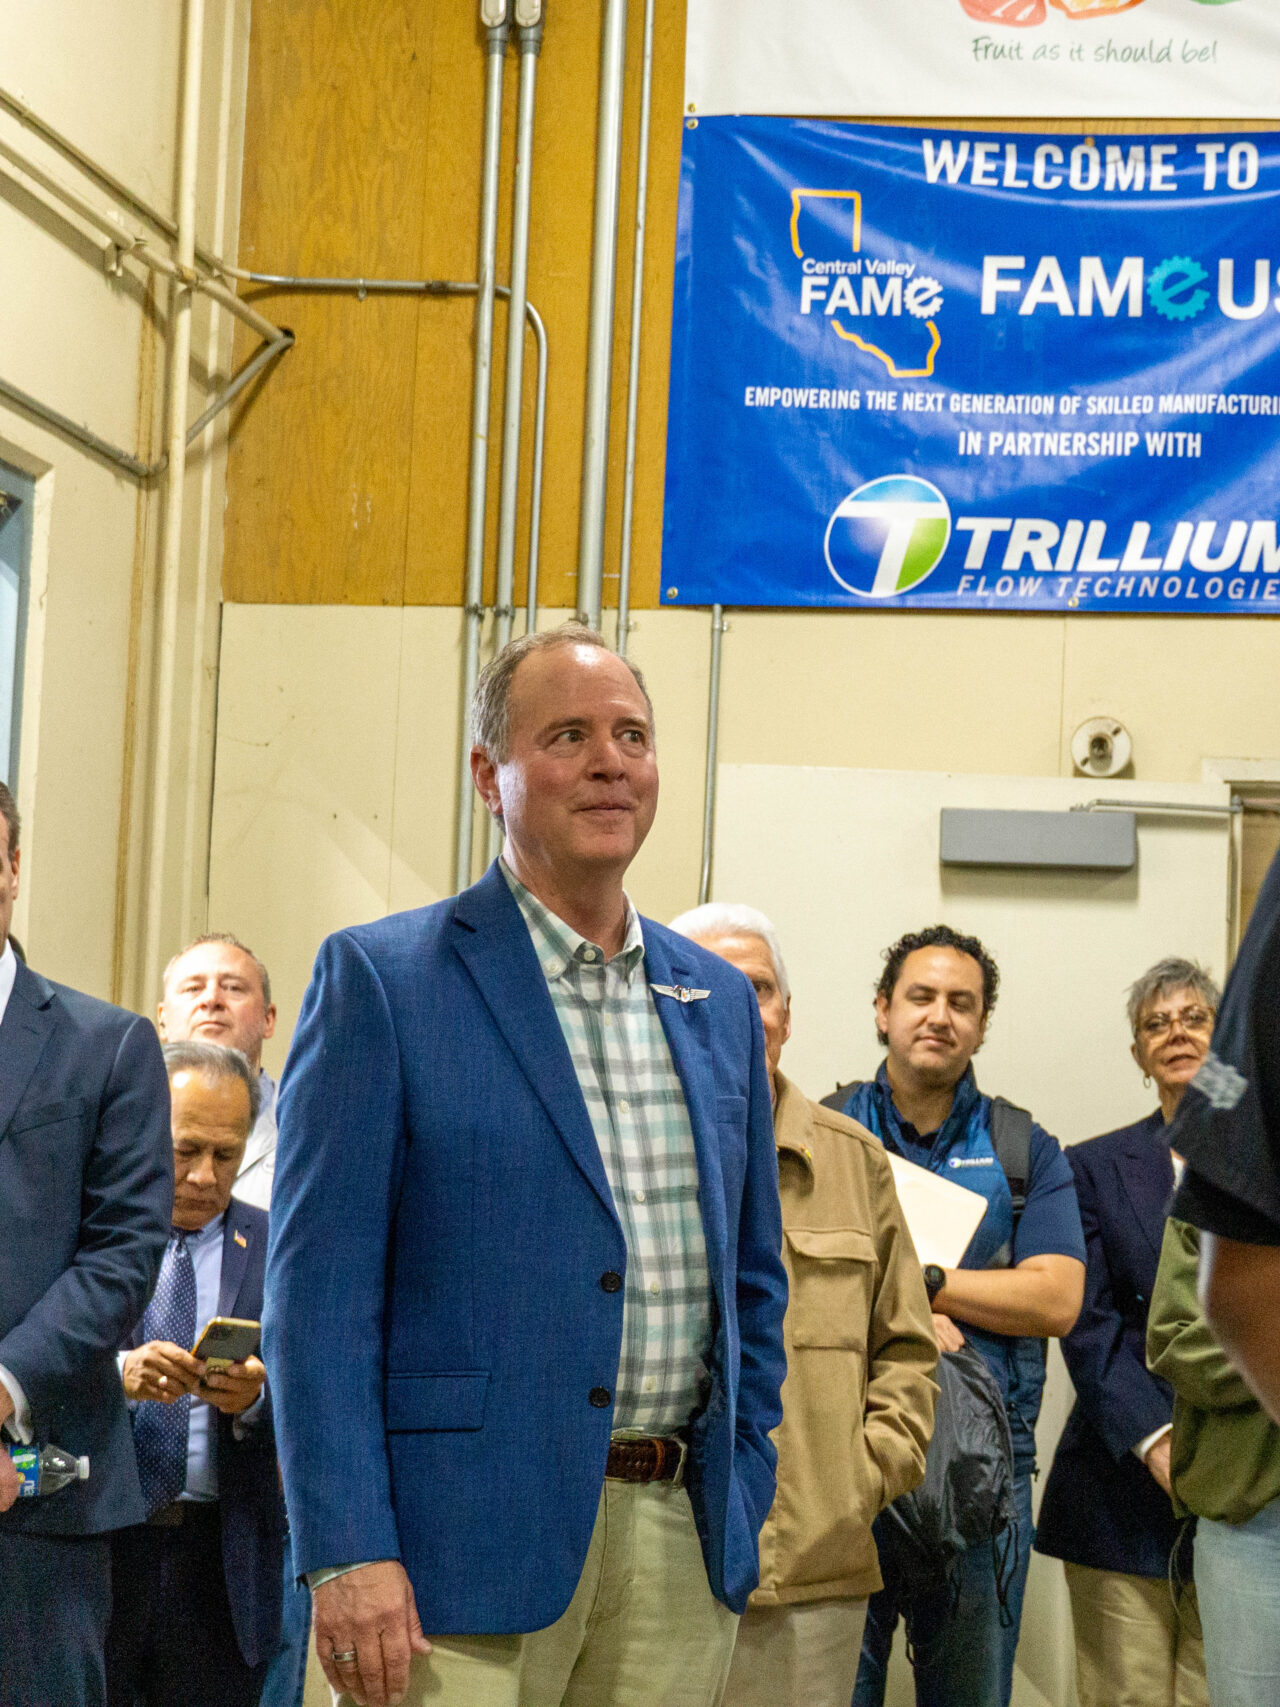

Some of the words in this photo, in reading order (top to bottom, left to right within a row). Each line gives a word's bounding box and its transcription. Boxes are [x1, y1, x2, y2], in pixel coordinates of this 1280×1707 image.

[972, 36, 1024, 62] Fruit
[1032, 44, 1060, 61] as
[1069, 40, 1084, 62] it
[1094, 38, 1173, 64] should
[1181, 39, 1218, 64] be!
[922, 138, 1178, 191] WELCOME
[1196, 142, 1259, 191] TO
[802, 258, 862, 275] Central
[865, 260, 915, 279] Valley
[744, 386, 860, 410] EMPOWERING
[866, 390, 898, 411] THE
[902, 393, 945, 413] NEXT
[950, 393, 1055, 415] GENERATION
[1059, 395, 1082, 415] OF
[1086, 395, 1154, 416] SKILLED
[958, 430, 982, 456] IN
[987, 430, 1140, 457] PARTNERSHIP
[1144, 431, 1203, 458] WITH
[957, 574, 1042, 597] FLOW
